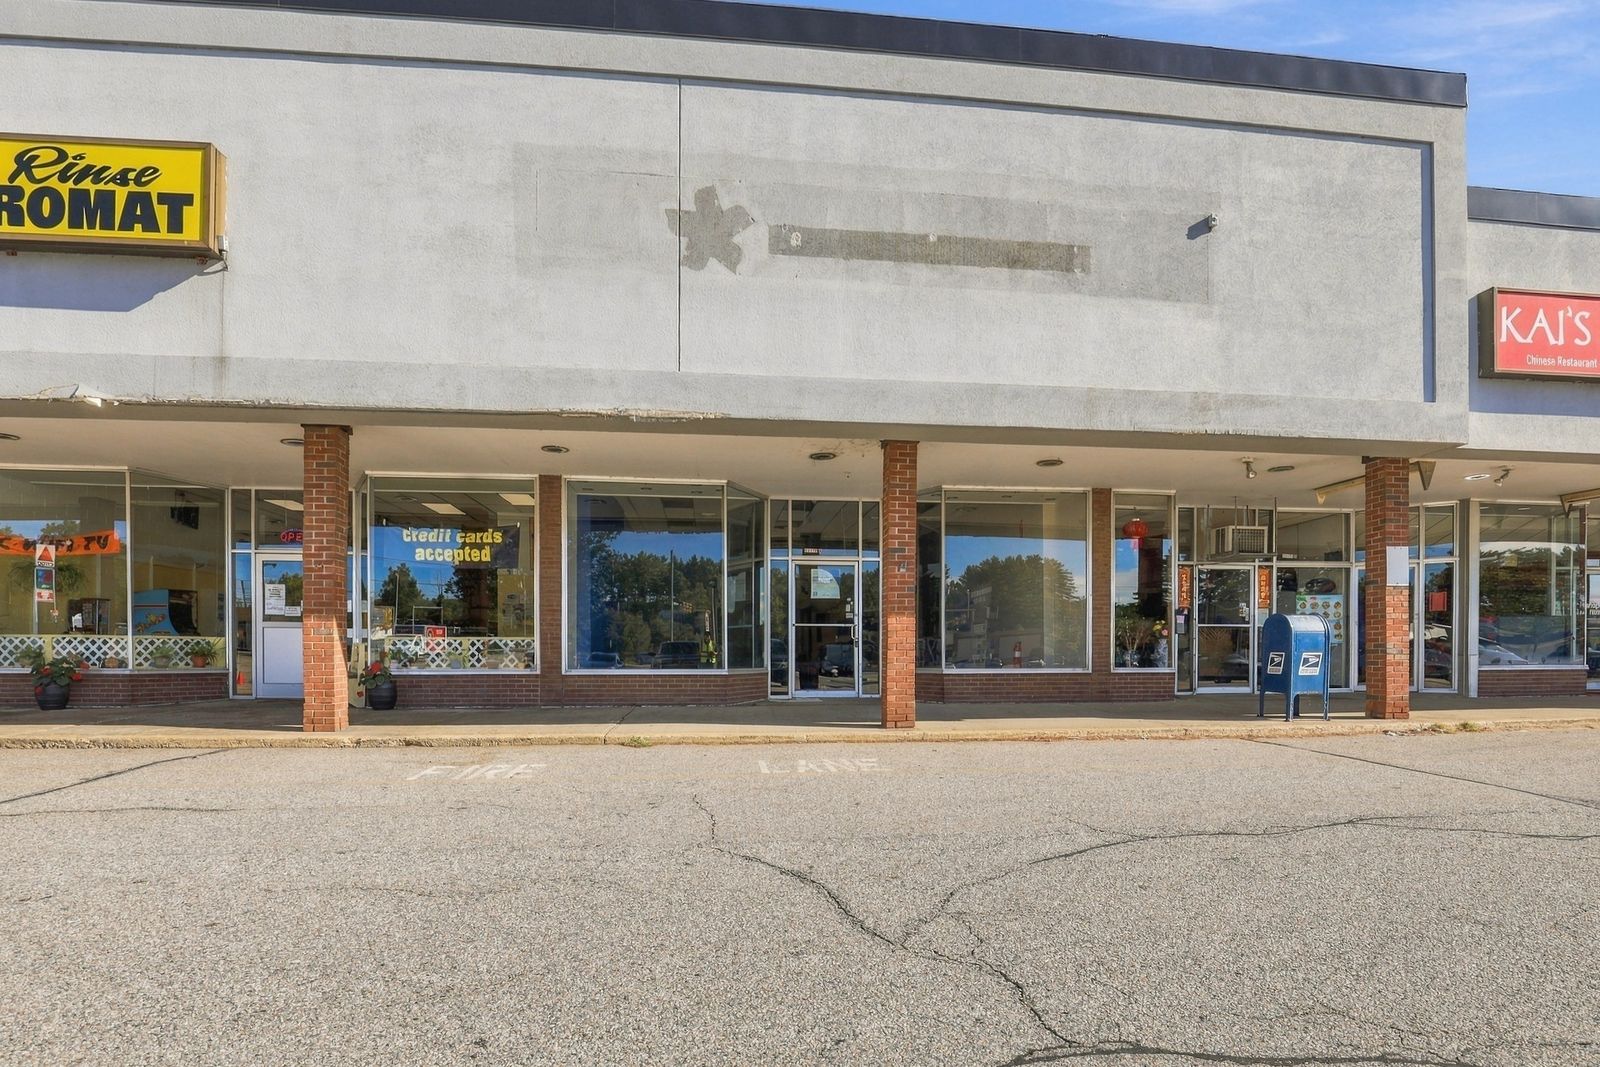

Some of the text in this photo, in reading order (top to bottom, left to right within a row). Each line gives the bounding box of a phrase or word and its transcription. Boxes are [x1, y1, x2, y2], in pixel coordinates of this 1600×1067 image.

[8, 145, 162, 188] Rinse
[0, 184, 194, 234] ROMAT
[1500, 305, 1592, 346] KAI'S
[1526, 354, 1598, 368] Chinese Restaurant
[280, 531, 304, 542] OPE
[455, 528, 503, 544] cards
[414, 546, 492, 566] accepted
